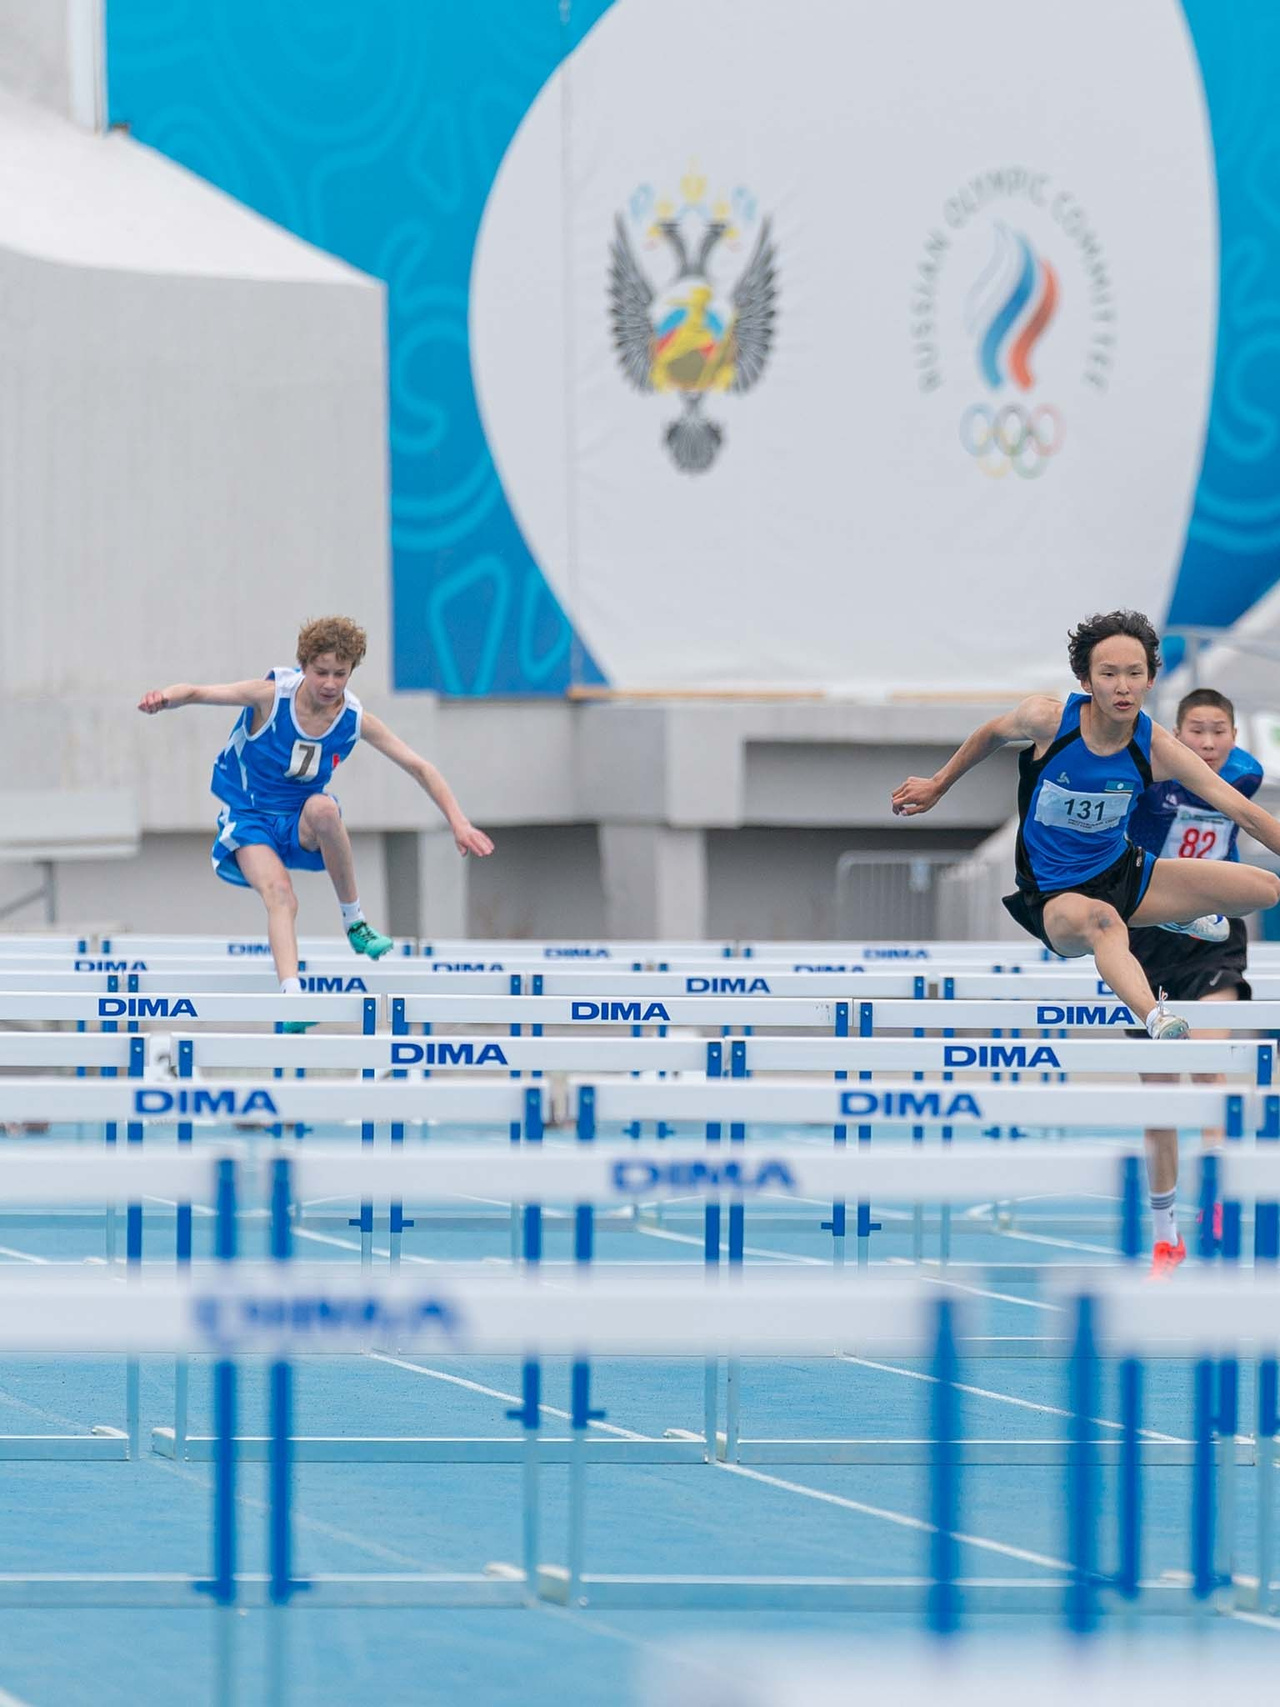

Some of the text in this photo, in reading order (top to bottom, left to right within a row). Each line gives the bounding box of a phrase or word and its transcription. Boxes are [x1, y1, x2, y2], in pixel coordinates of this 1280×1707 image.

[912, 229, 950, 392] RUSSIAN
[942, 165, 1050, 229] OLYMPIC
[297, 744, 316, 777] 7
[1064, 798, 1106, 822] 131
[1177, 827, 1217, 859] 82
[227, 943, 272, 957] DIM
[542, 946, 611, 959] DIMA
[73, 960, 147, 972] DIMA
[685, 977, 770, 995] DIMA
[98, 998, 198, 1018] DIMA
[571, 1002, 671, 1021] DIMA
[1036, 1005, 1136, 1025] DIMA
[390, 1042, 507, 1066] DIMA
[943, 1045, 1061, 1069] DIMA
[134, 1088, 278, 1116] DIMA
[840, 1091, 982, 1119] DIMA
[612, 1160, 796, 1193] DIMA
